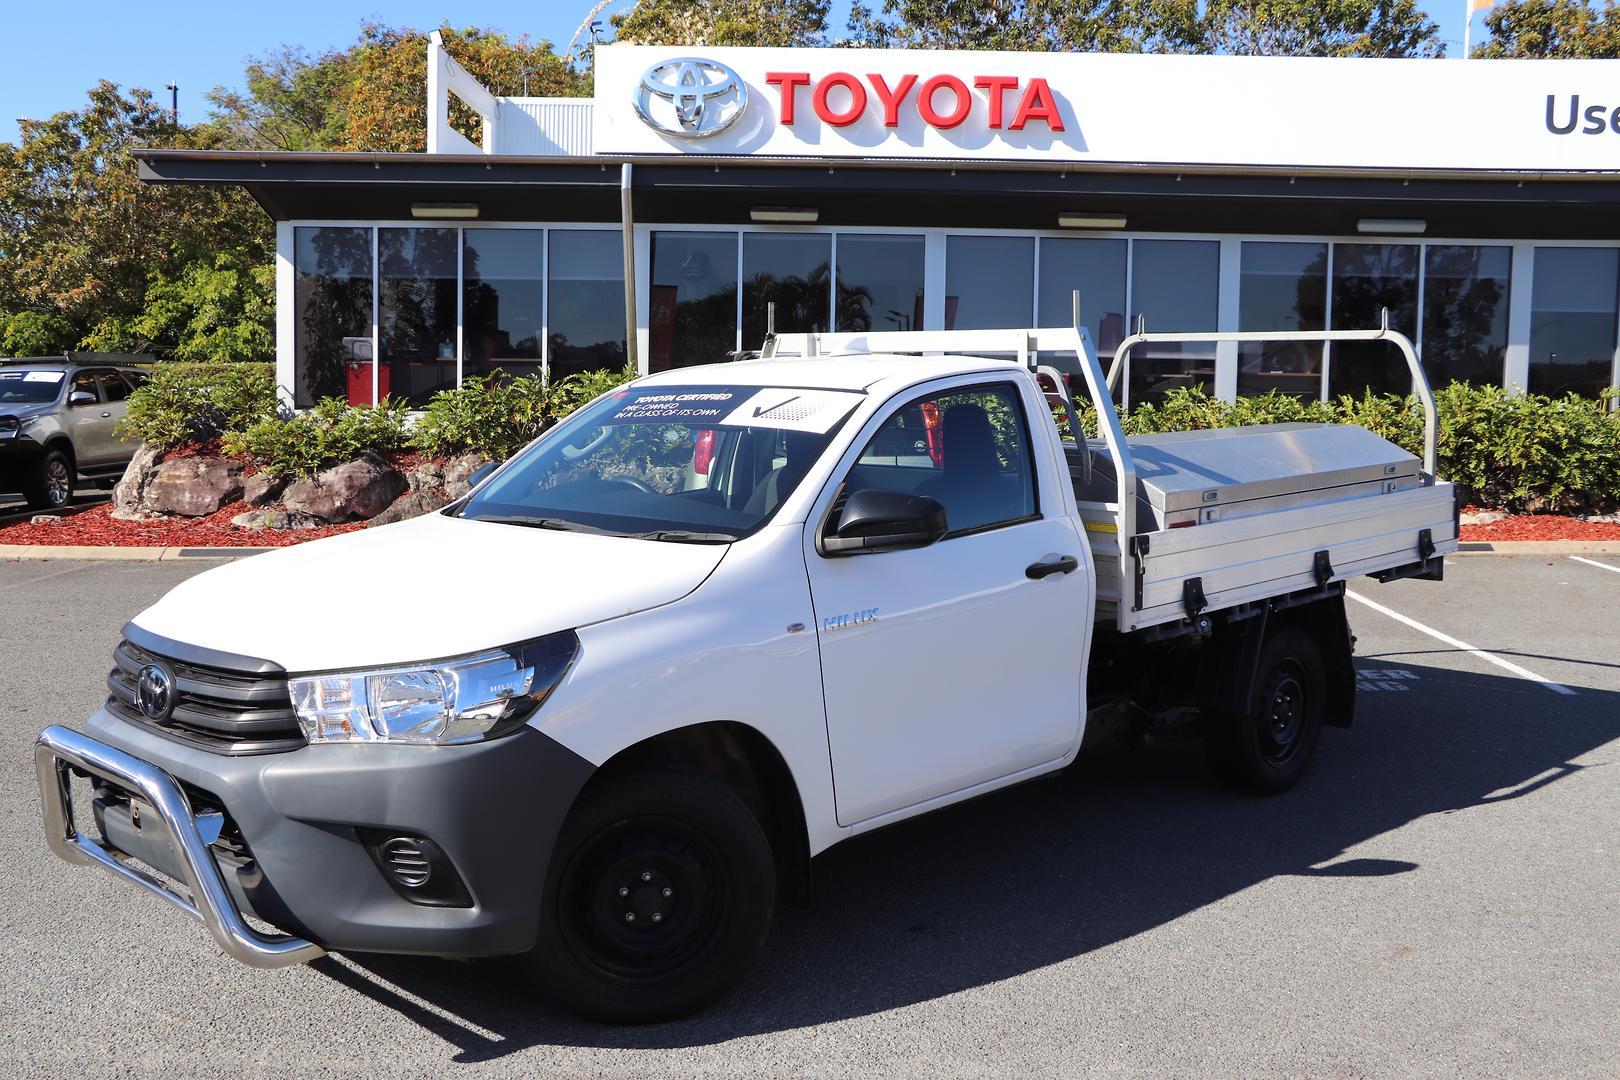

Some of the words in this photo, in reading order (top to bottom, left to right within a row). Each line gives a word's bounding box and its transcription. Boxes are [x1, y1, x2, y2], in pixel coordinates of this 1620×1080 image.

[765, 72, 1065, 132] TOYOTA
[634, 394, 676, 403] TOYOTA
[676, 393, 733, 401] CERTIFIED
[622, 403, 679, 412] PRE-OWNED
[824, 608, 879, 632] HILUX
